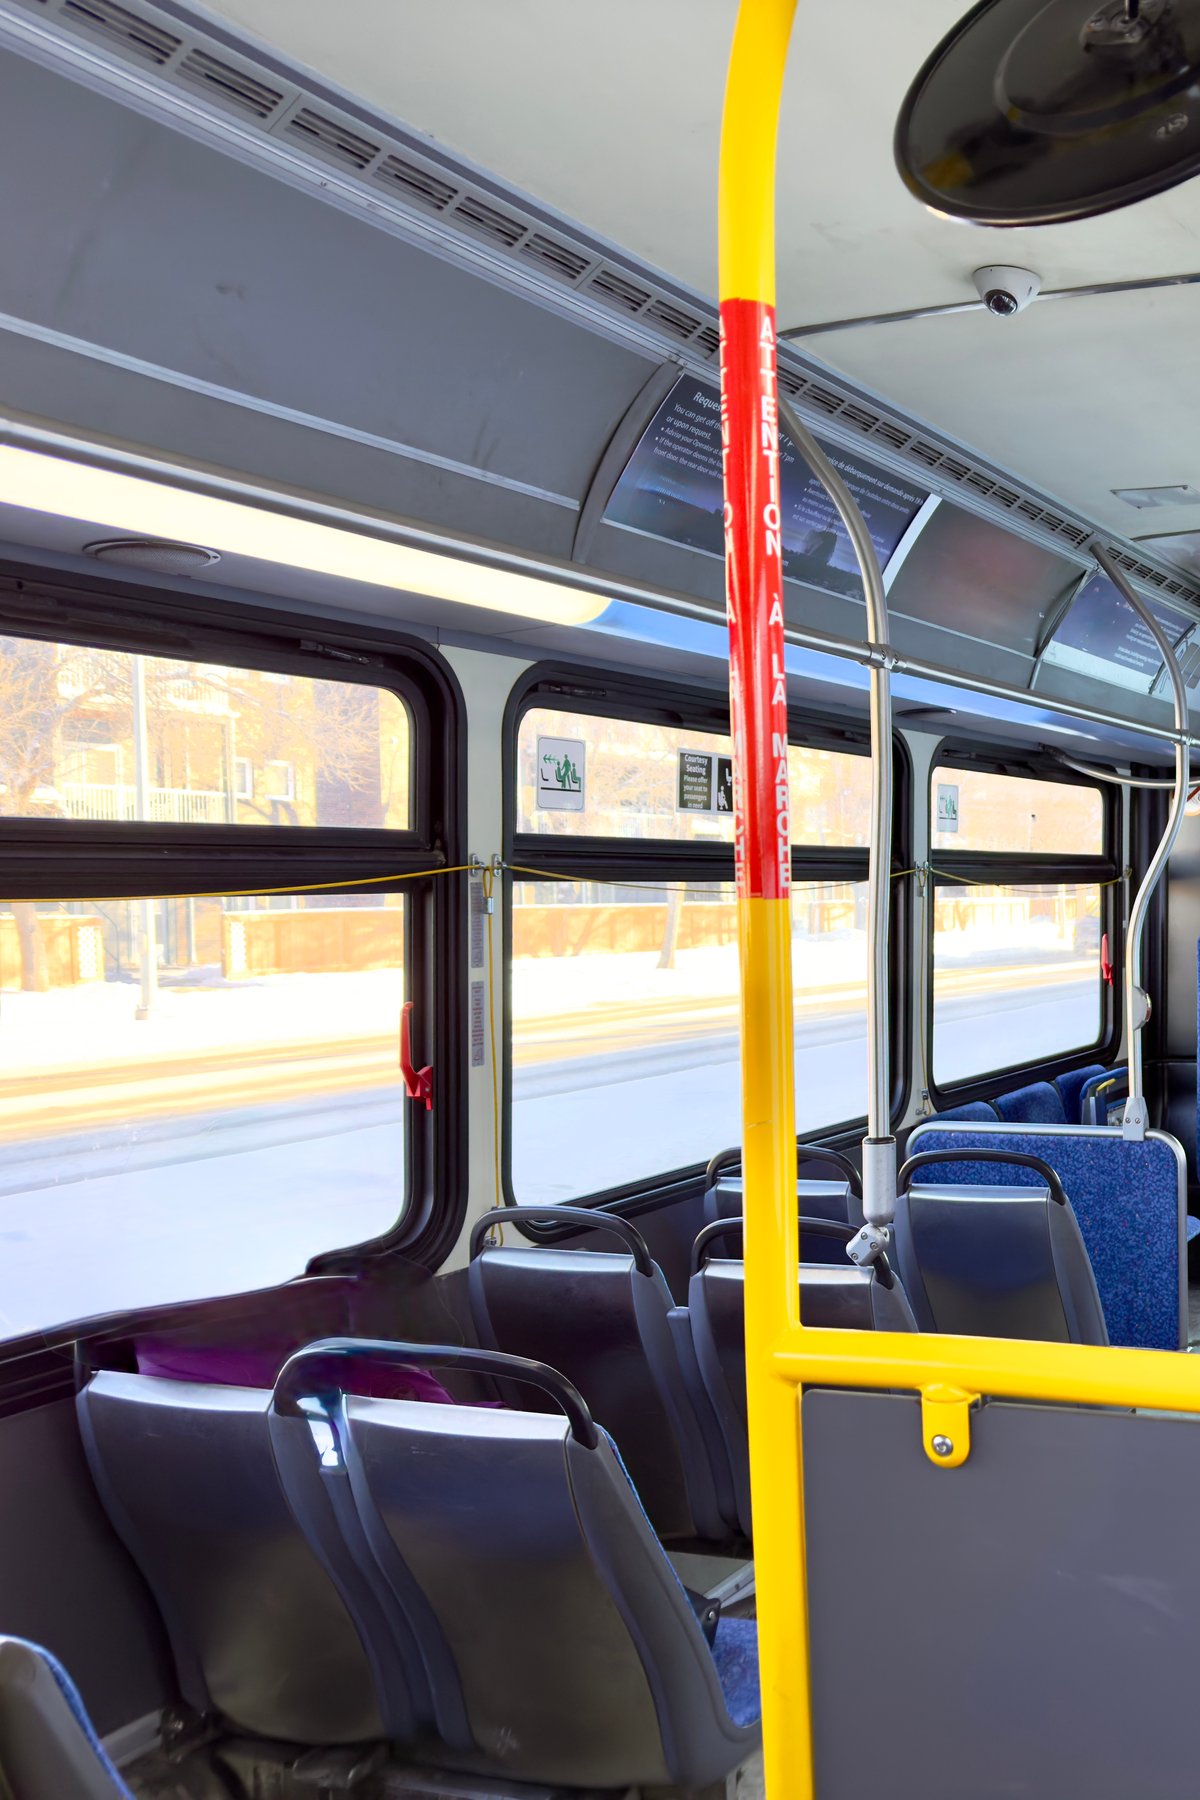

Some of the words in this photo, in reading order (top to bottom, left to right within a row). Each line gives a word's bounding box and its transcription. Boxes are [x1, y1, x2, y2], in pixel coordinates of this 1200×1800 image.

[693, 391, 722, 412] Reques
[673, 420, 690, 430] upon
[674, 403, 685, 414] You
[685, 410, 695, 419] can
[695, 415, 707, 423] get
[706, 418, 716, 428] off
[760, 315, 781, 558] ATTENTION
[768, 592, 784, 627] À
[771, 653, 787, 706] LA
[685, 754, 708, 766] Courtesy
[687, 764, 706, 775] Seating
[772, 732, 791, 888] MARCHE
